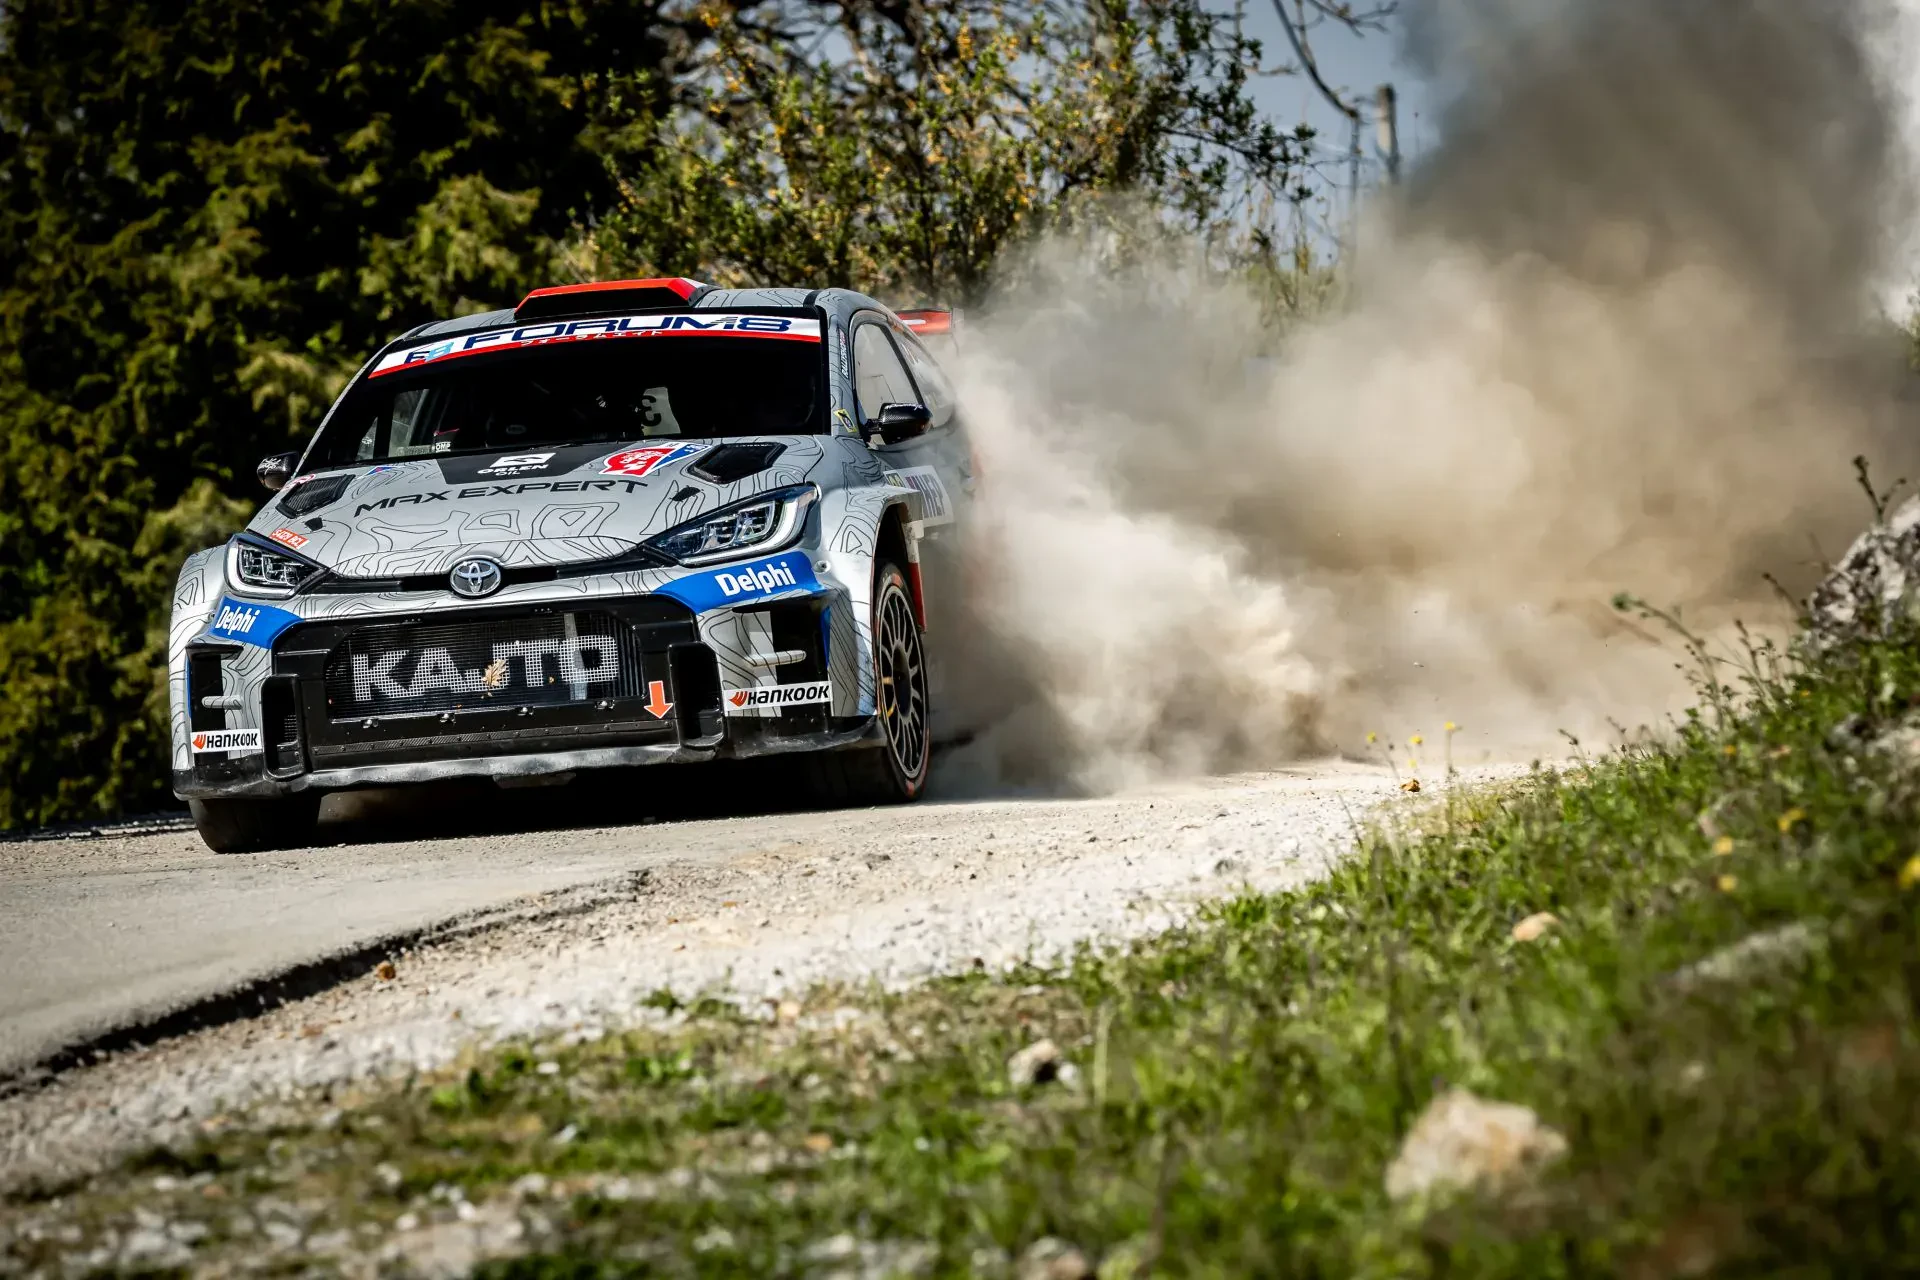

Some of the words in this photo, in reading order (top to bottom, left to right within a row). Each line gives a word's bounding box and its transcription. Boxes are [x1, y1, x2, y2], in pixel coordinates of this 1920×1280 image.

[463, 316, 791, 350] FORUM8
[477, 464, 549, 474] ORLEN
[354, 490, 450, 518] MAX
[457, 480, 648, 499] EXPERT
[714, 561, 797, 597] Delphi
[214, 605, 261, 635] Delphi
